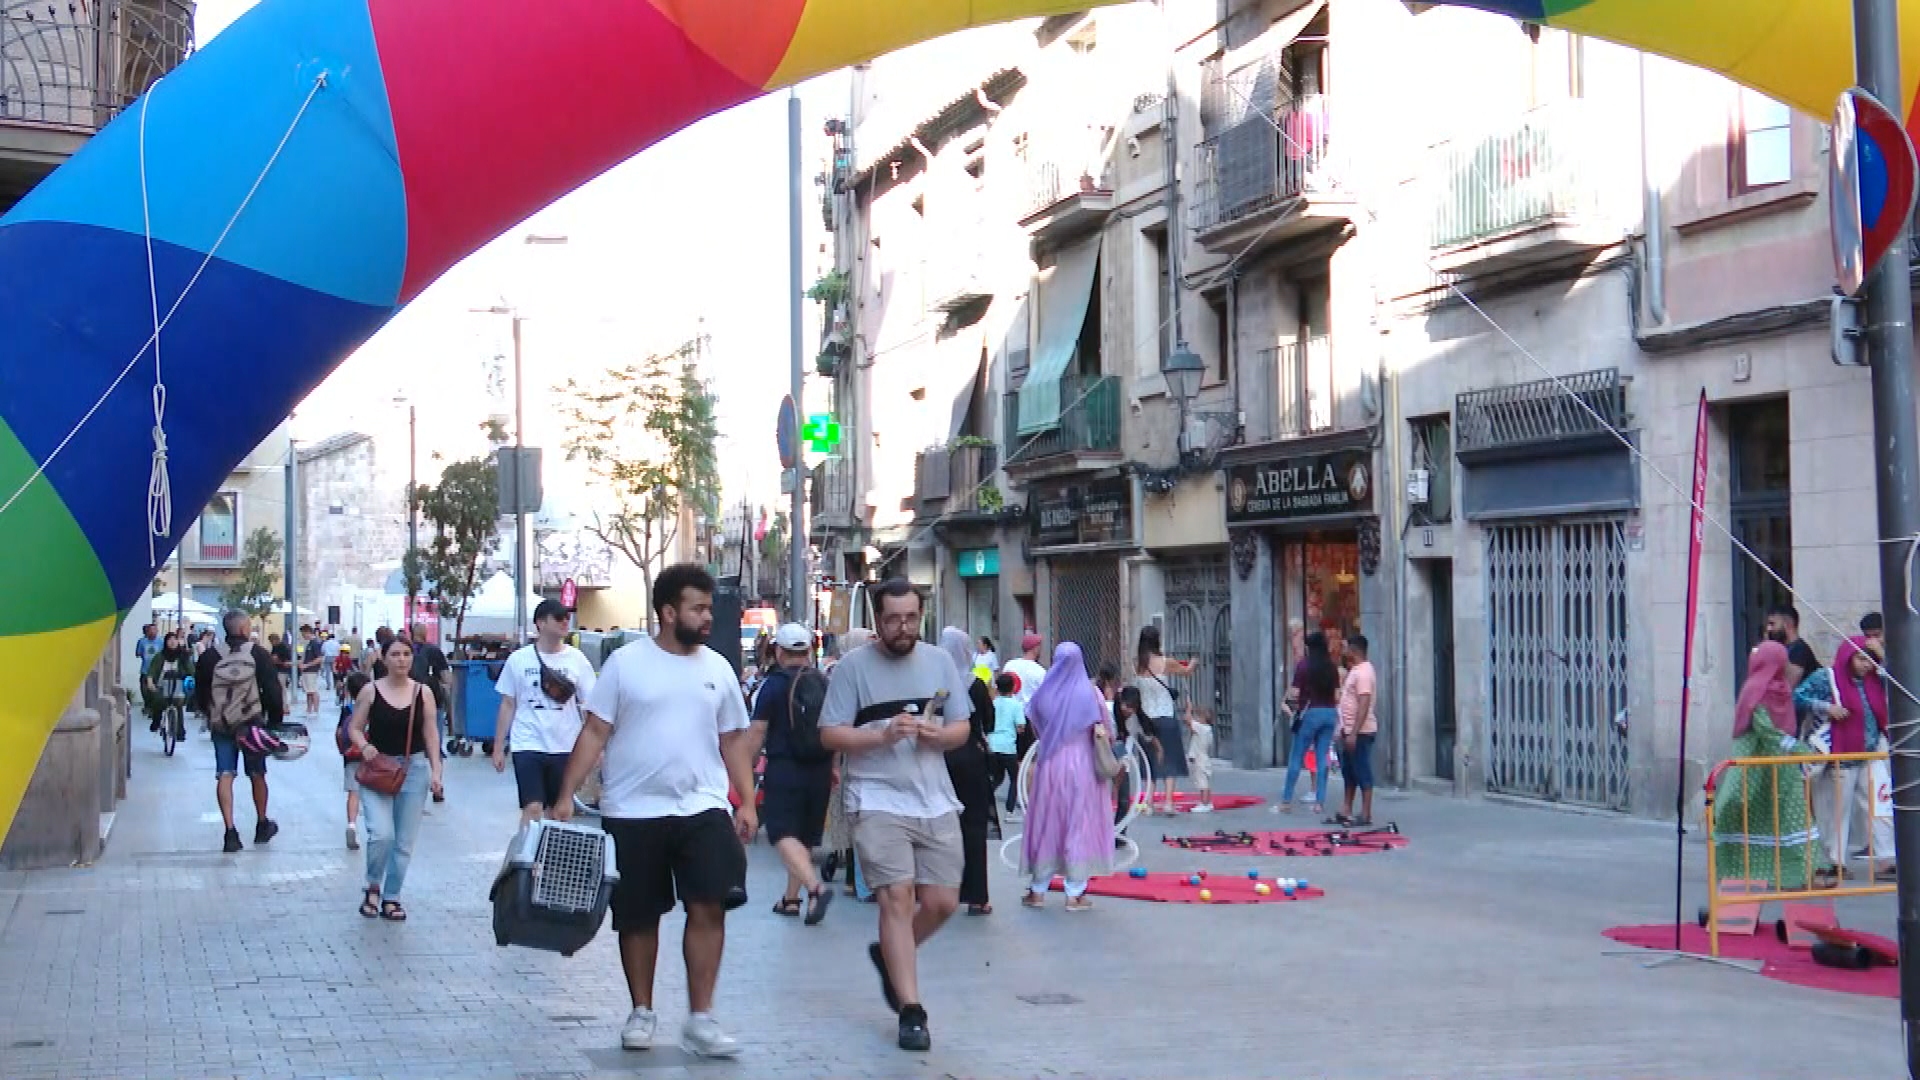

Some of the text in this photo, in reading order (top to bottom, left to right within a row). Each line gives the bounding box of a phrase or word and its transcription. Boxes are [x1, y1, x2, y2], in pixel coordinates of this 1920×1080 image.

[1255, 463, 1337, 496] ABELLA
[1272, 497, 1281, 511] DE
[1282, 495, 1292, 509] LA
[1292, 494, 1322, 509] SAGRADA
